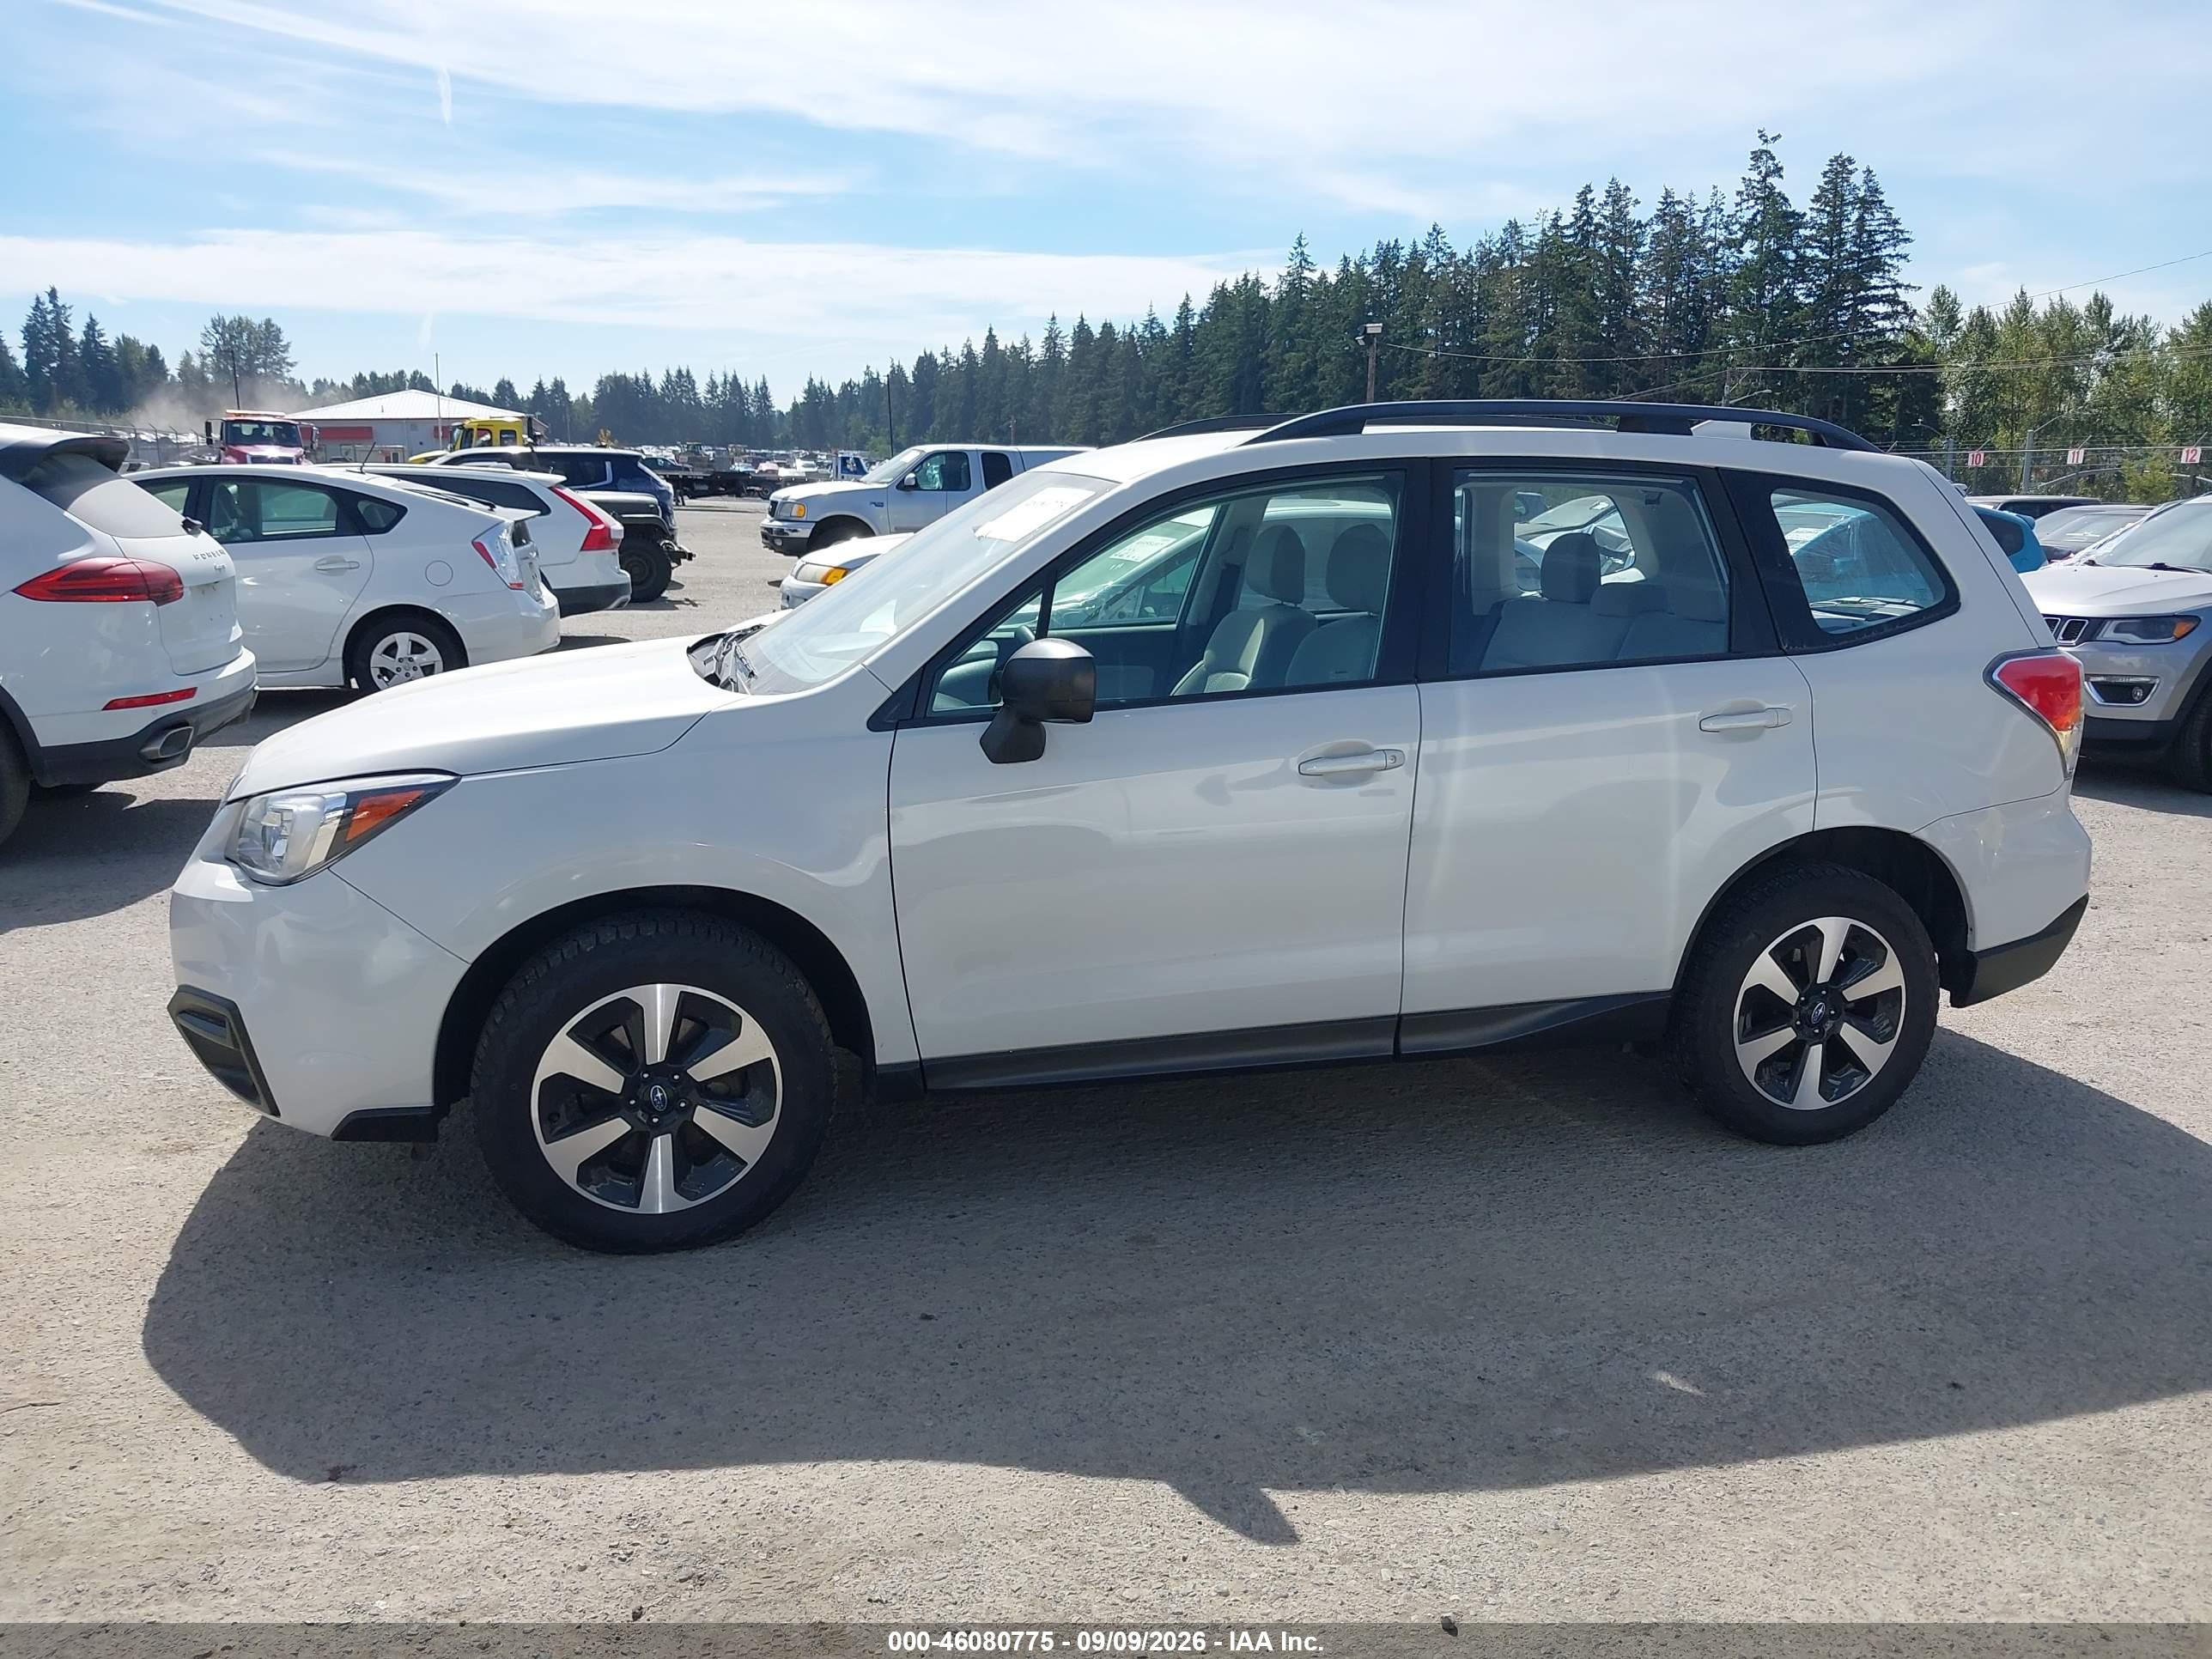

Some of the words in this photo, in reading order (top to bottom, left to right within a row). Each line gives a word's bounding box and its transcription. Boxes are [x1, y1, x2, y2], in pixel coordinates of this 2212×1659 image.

[1971, 453, 1982, 465] 10
[2071, 450, 2081, 464] 11
[2185, 448, 2198, 463] 12
